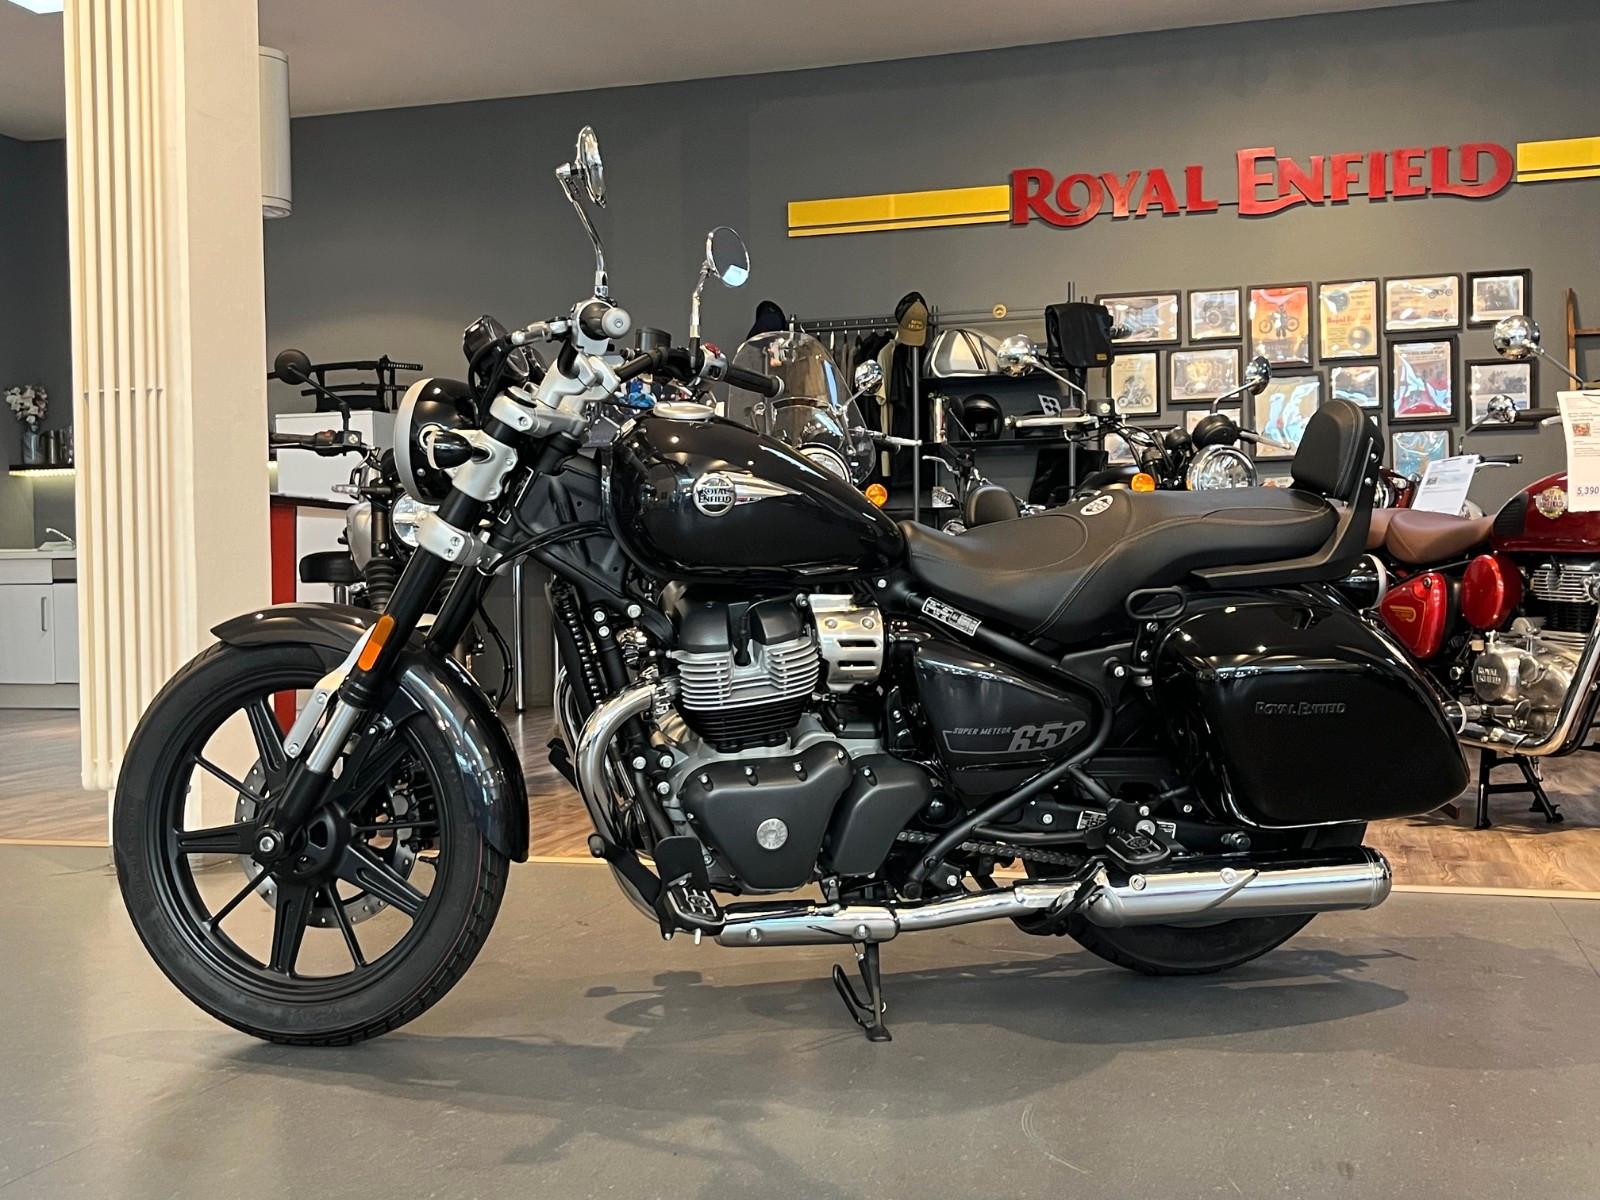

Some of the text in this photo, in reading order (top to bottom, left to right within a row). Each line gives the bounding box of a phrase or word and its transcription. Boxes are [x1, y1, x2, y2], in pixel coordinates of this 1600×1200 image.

[1011, 142, 1515, 227] ROYAL ENFIELD
[698, 495, 732, 504] ENFIELD
[1477, 665, 1498, 676] ROYAL
[1255, 701, 1297, 715] ROYAL
[952, 720, 1087, 753] SUPER METEOR 650
